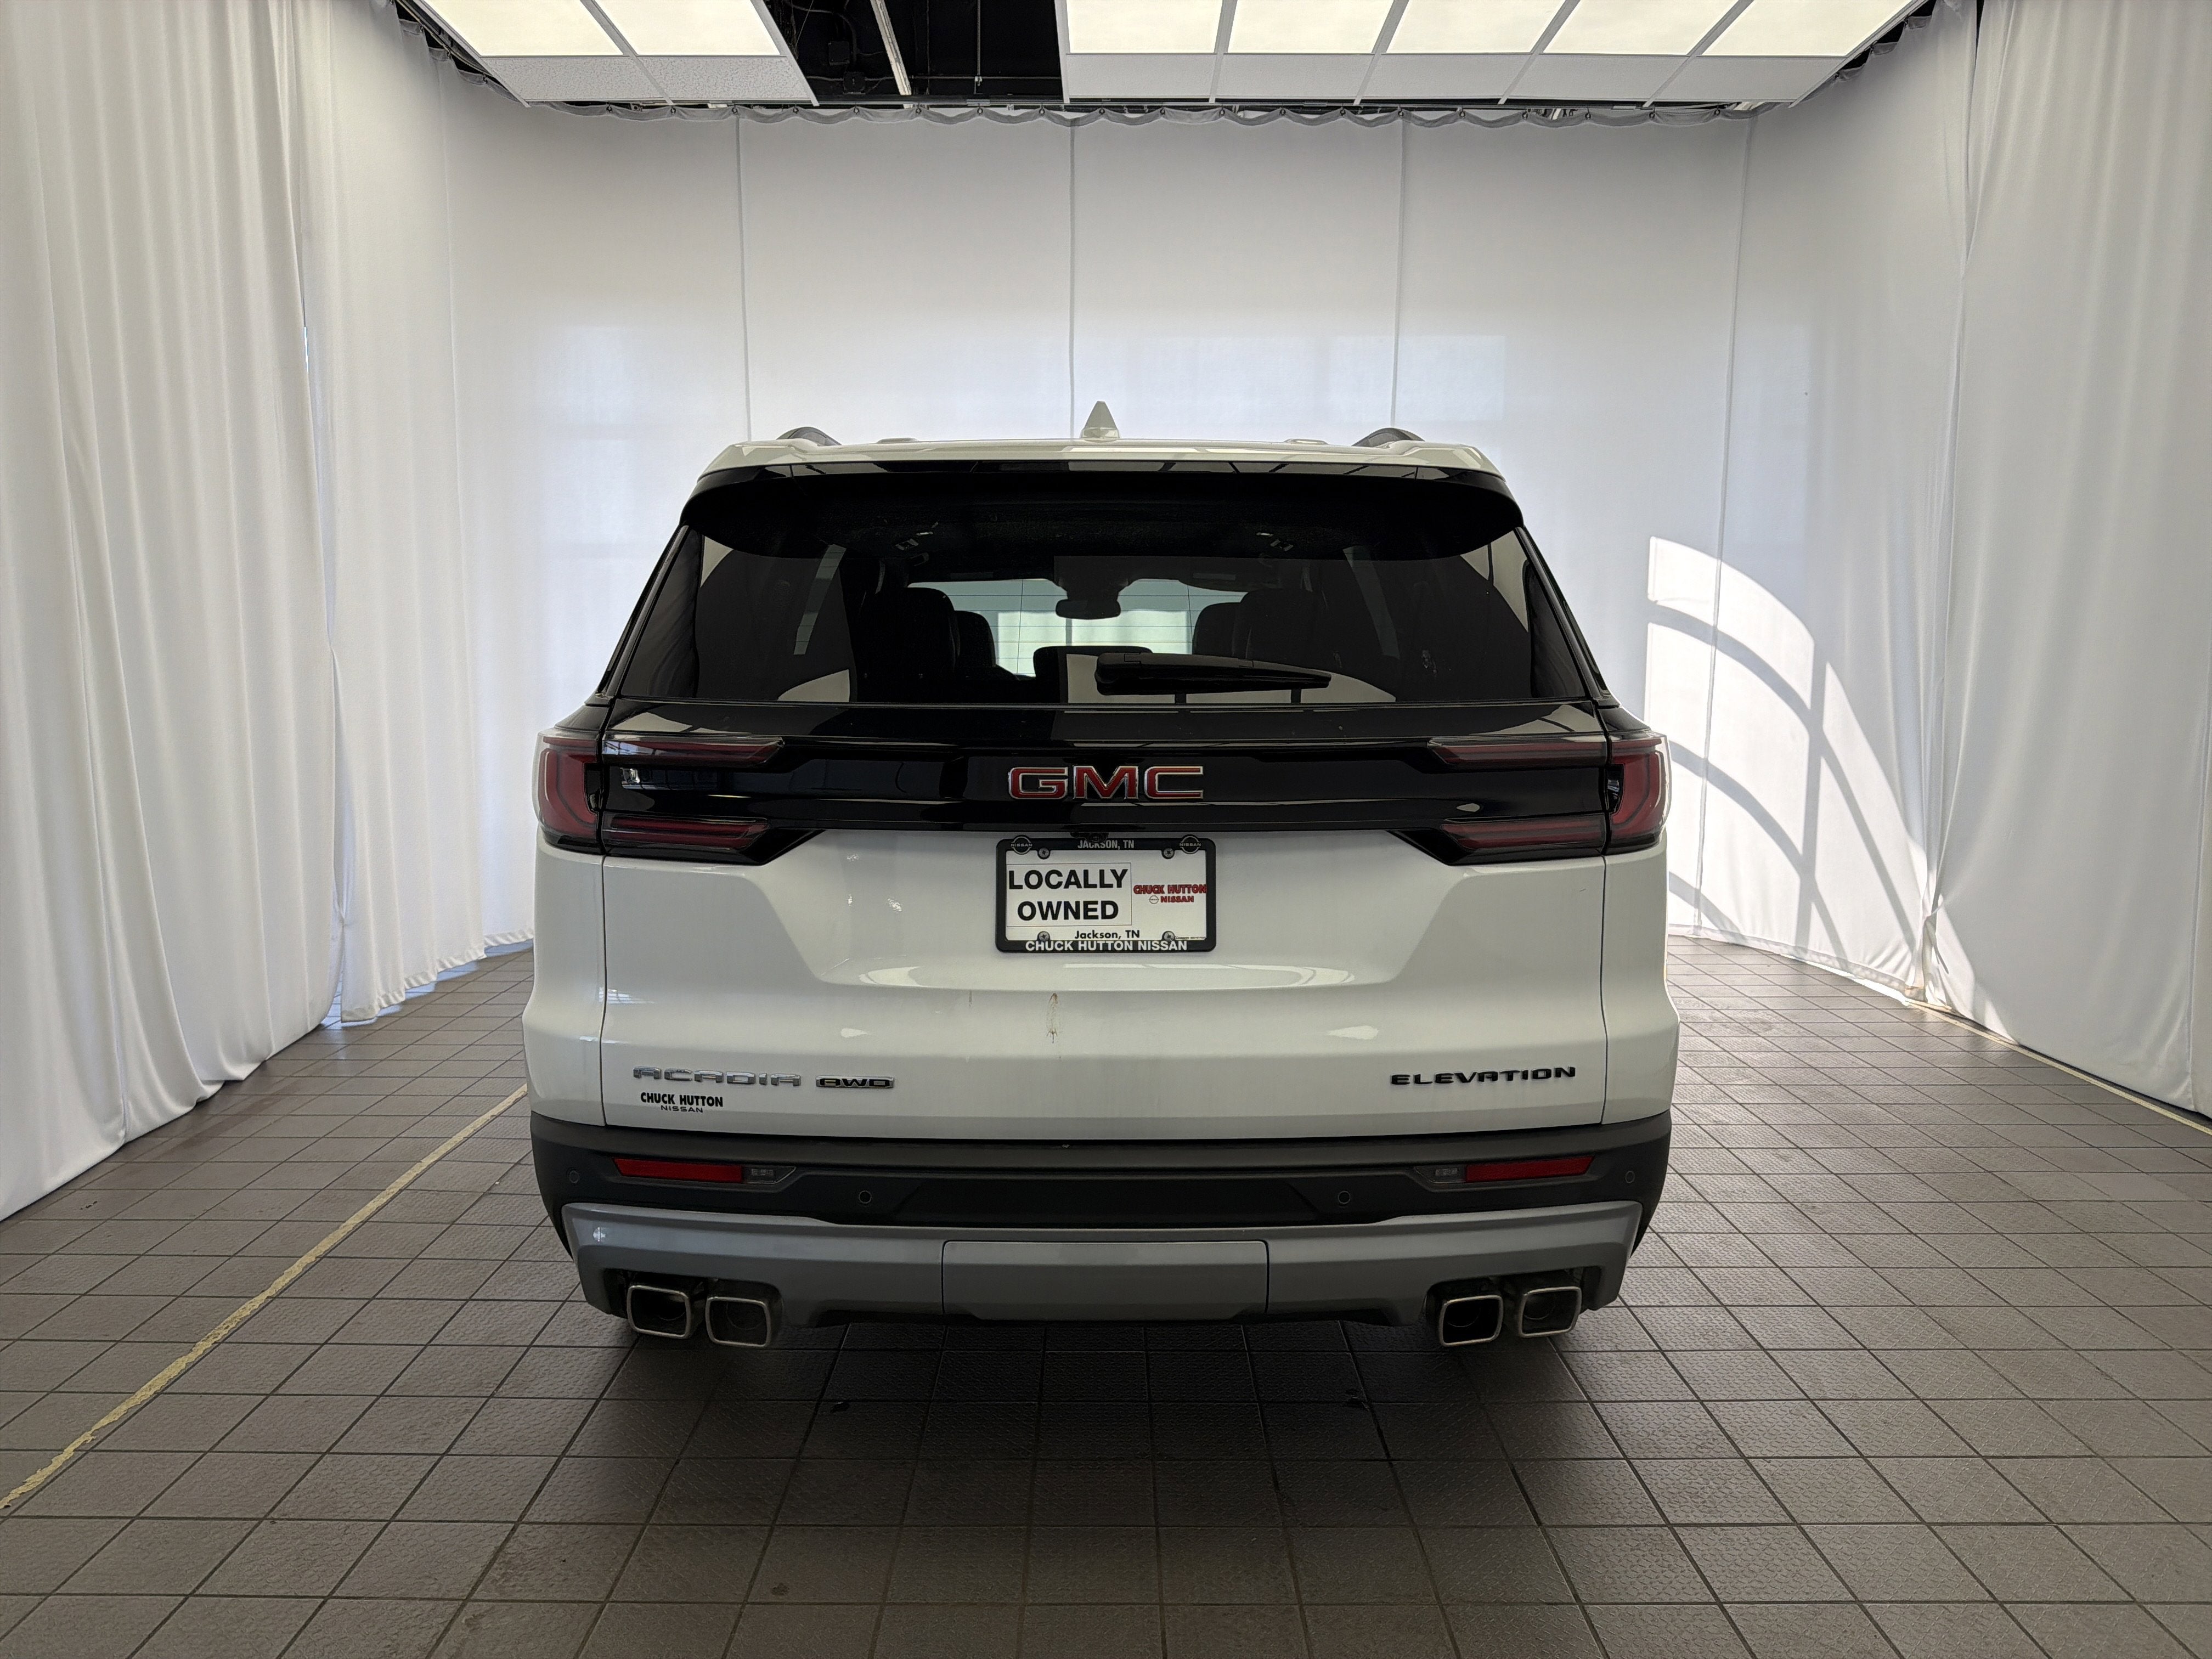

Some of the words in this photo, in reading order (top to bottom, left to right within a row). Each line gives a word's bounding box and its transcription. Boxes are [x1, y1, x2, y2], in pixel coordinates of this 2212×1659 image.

[1008, 765, 1203, 799] GMC
[1123, 840, 1135, 849] TN
[1008, 868, 1128, 889] LOCALLY
[1133, 884, 1165, 894] CHUCK
[1167, 884, 1207, 894] HUTTON
[1018, 900, 1119, 921] OWNED
[1075, 930, 1121, 939] Jackson,
[1125, 930, 1140, 938] TN
[1025, 941, 1074, 951] CHUCK
[1078, 941, 1133, 951] HUTTON
[1138, 940, 1187, 951] NISSAN
[633, 1066, 801, 1087] ACADIA
[817, 1077, 892, 1088] AWD
[1391, 1066, 1576, 1085] ELEVATION
[640, 1092, 675, 1105] CHUCK
[680, 1094, 723, 1107] HUTTON
[661, 1105, 703, 1113] NISSAN
